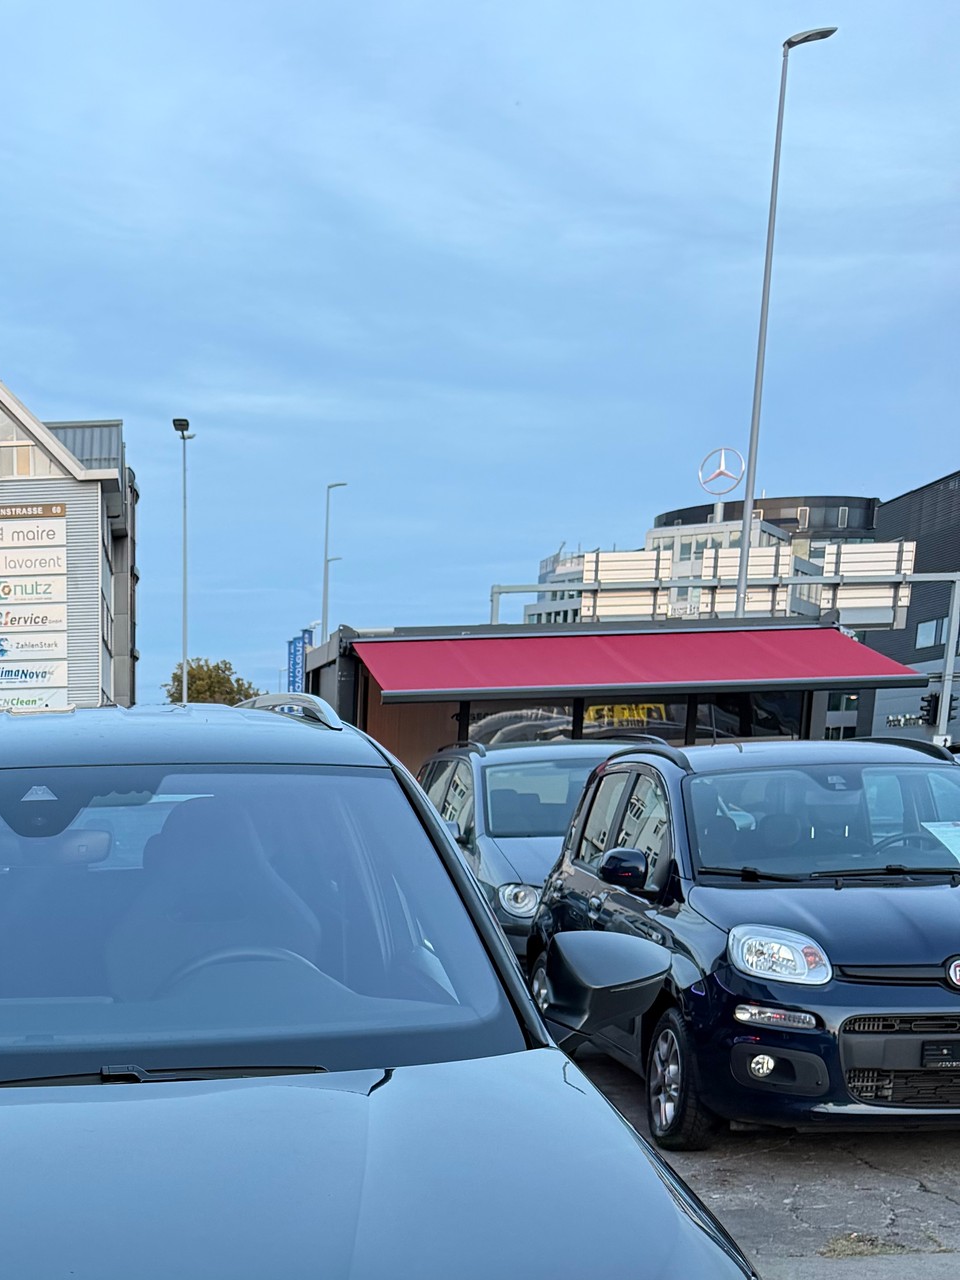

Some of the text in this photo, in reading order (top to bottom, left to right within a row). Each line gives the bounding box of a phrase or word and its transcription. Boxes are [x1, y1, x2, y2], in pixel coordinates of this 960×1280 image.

[11, 525, 56, 542] maire
[4, 555, 63, 570] lavorent
[15, 640, 58, 650] ZahlenStark
